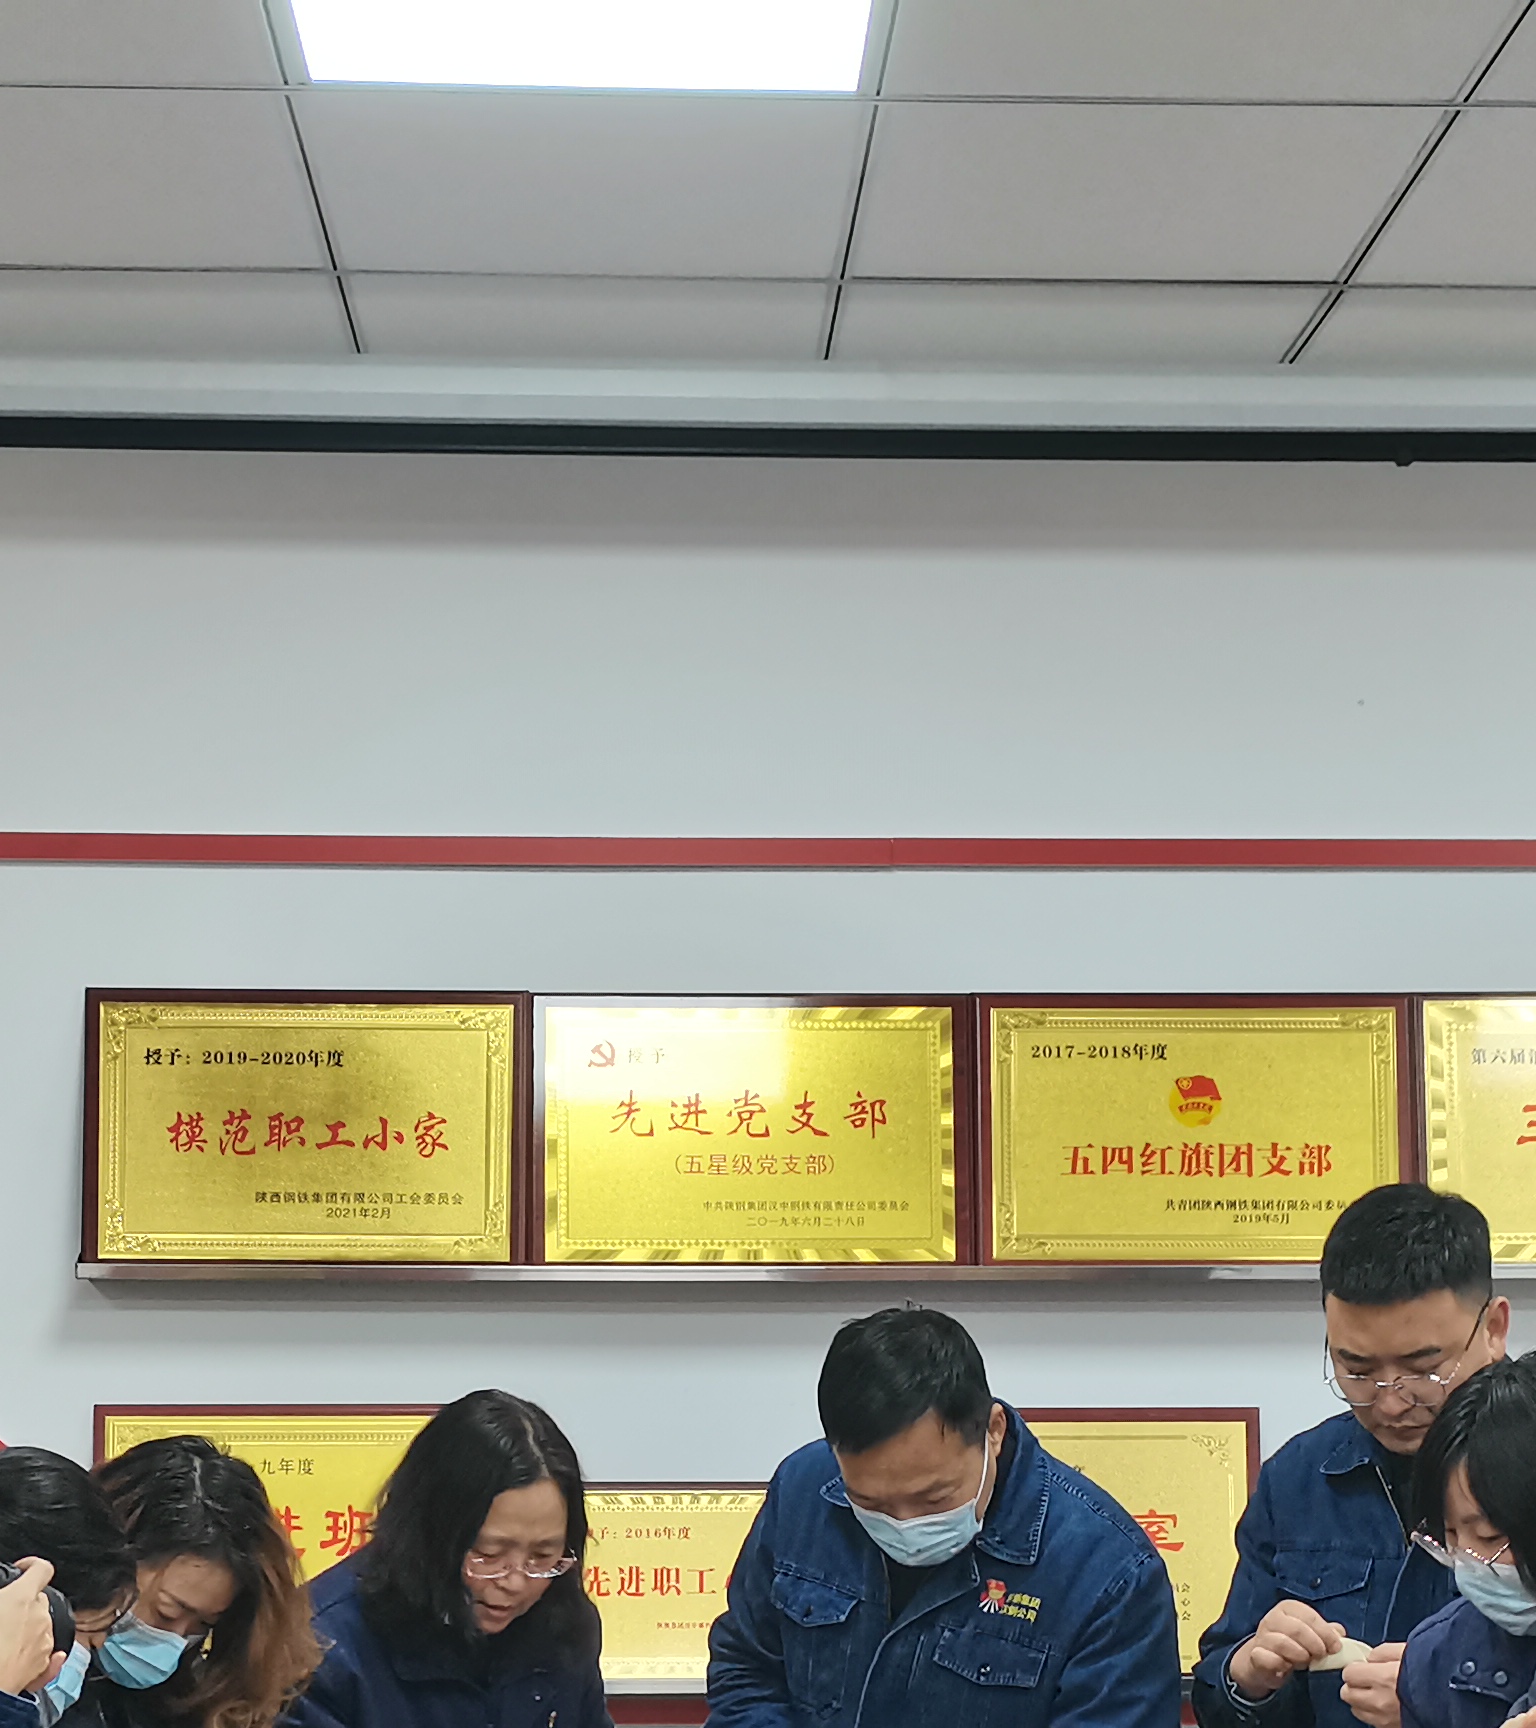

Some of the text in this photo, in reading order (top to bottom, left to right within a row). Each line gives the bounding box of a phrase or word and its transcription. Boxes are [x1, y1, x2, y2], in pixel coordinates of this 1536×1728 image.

[1031, 1044, 1168, 1061] 2017-2018年度
[609, 1089, 888, 1139] 先进党支部
[166, 1107, 450, 1159] 模范职工小家
[1060, 1141, 1333, 1178] 五四红旗团支部
[326, 1207, 391, 1220] 2021年2月
[583, 1565, 732, 1598] 先进职工
